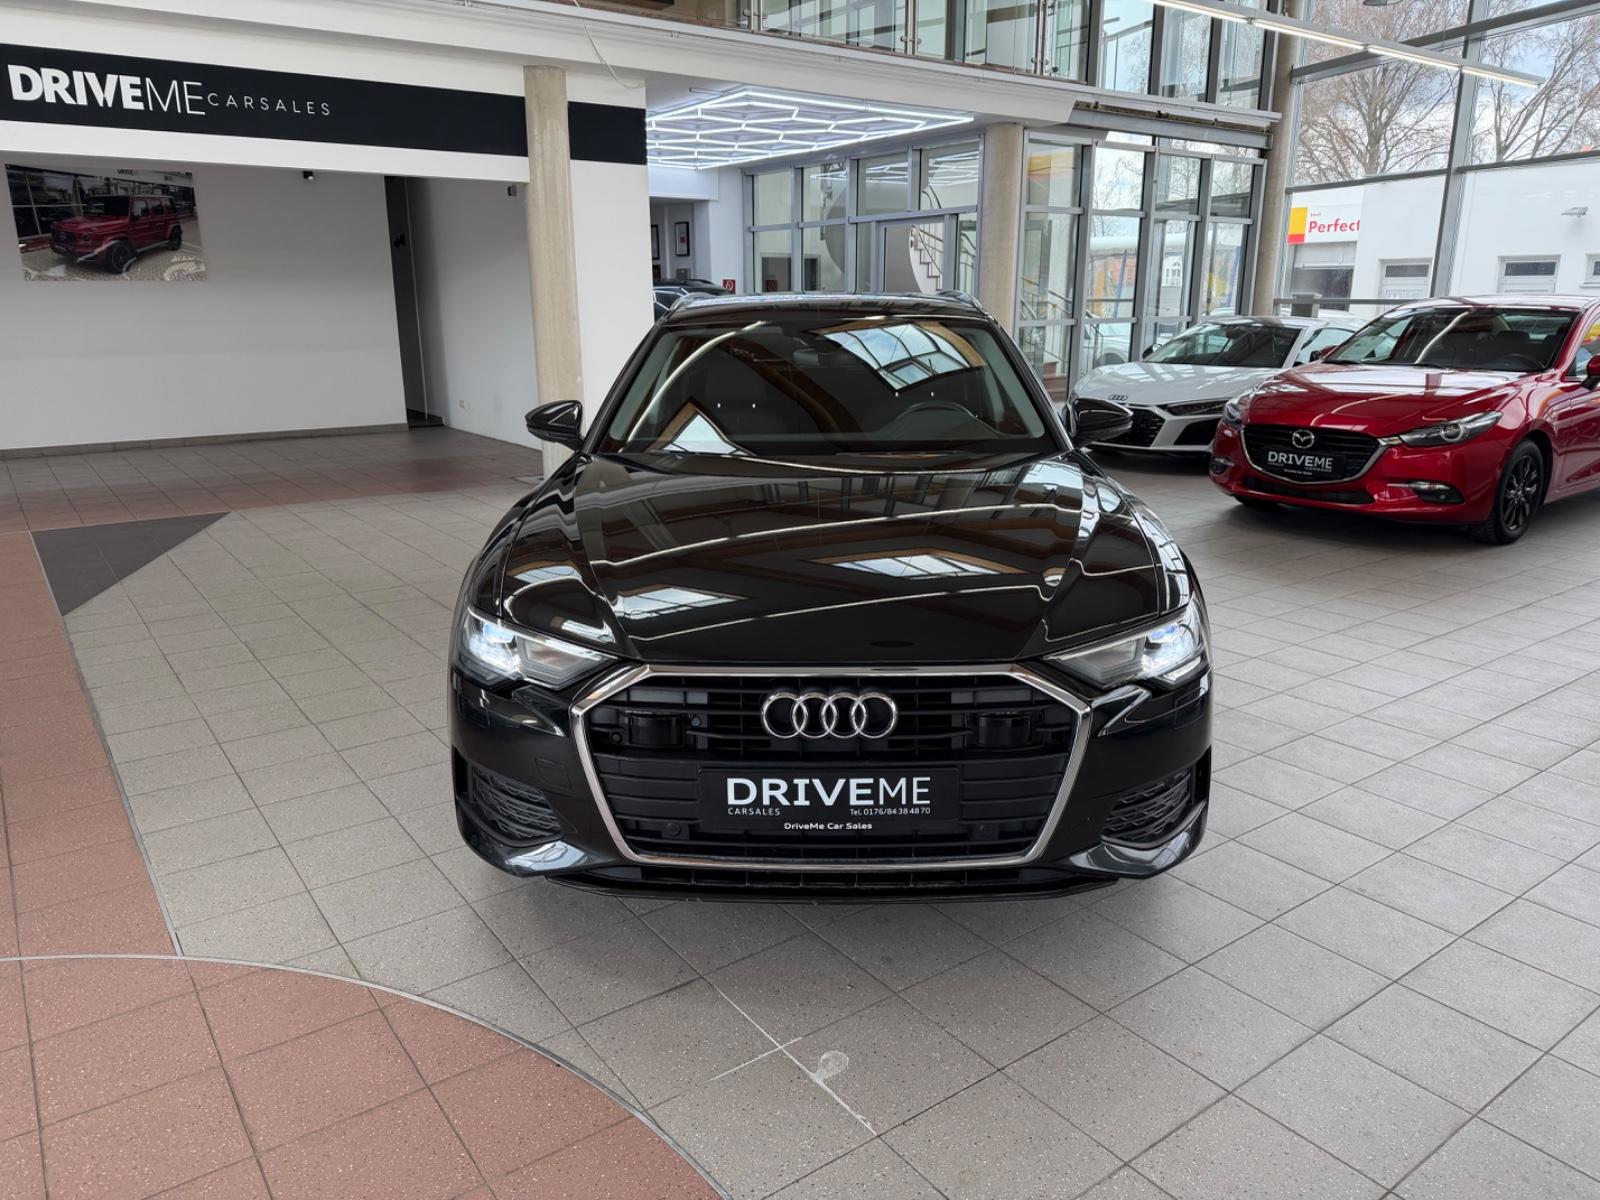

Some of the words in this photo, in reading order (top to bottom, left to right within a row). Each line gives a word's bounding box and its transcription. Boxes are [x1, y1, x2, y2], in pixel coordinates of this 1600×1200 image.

[7, 63, 205, 116] DRIVEME
[207, 92, 330, 116] CARSALES
[1268, 451, 1334, 470] DRIVEME
[726, 777, 931, 807] DRIVEME
[727, 807, 781, 816] CARSALES
[783, 822, 825, 830] DriveMe
[827, 822, 844, 830] Car
[846, 822, 873, 830] Sales
